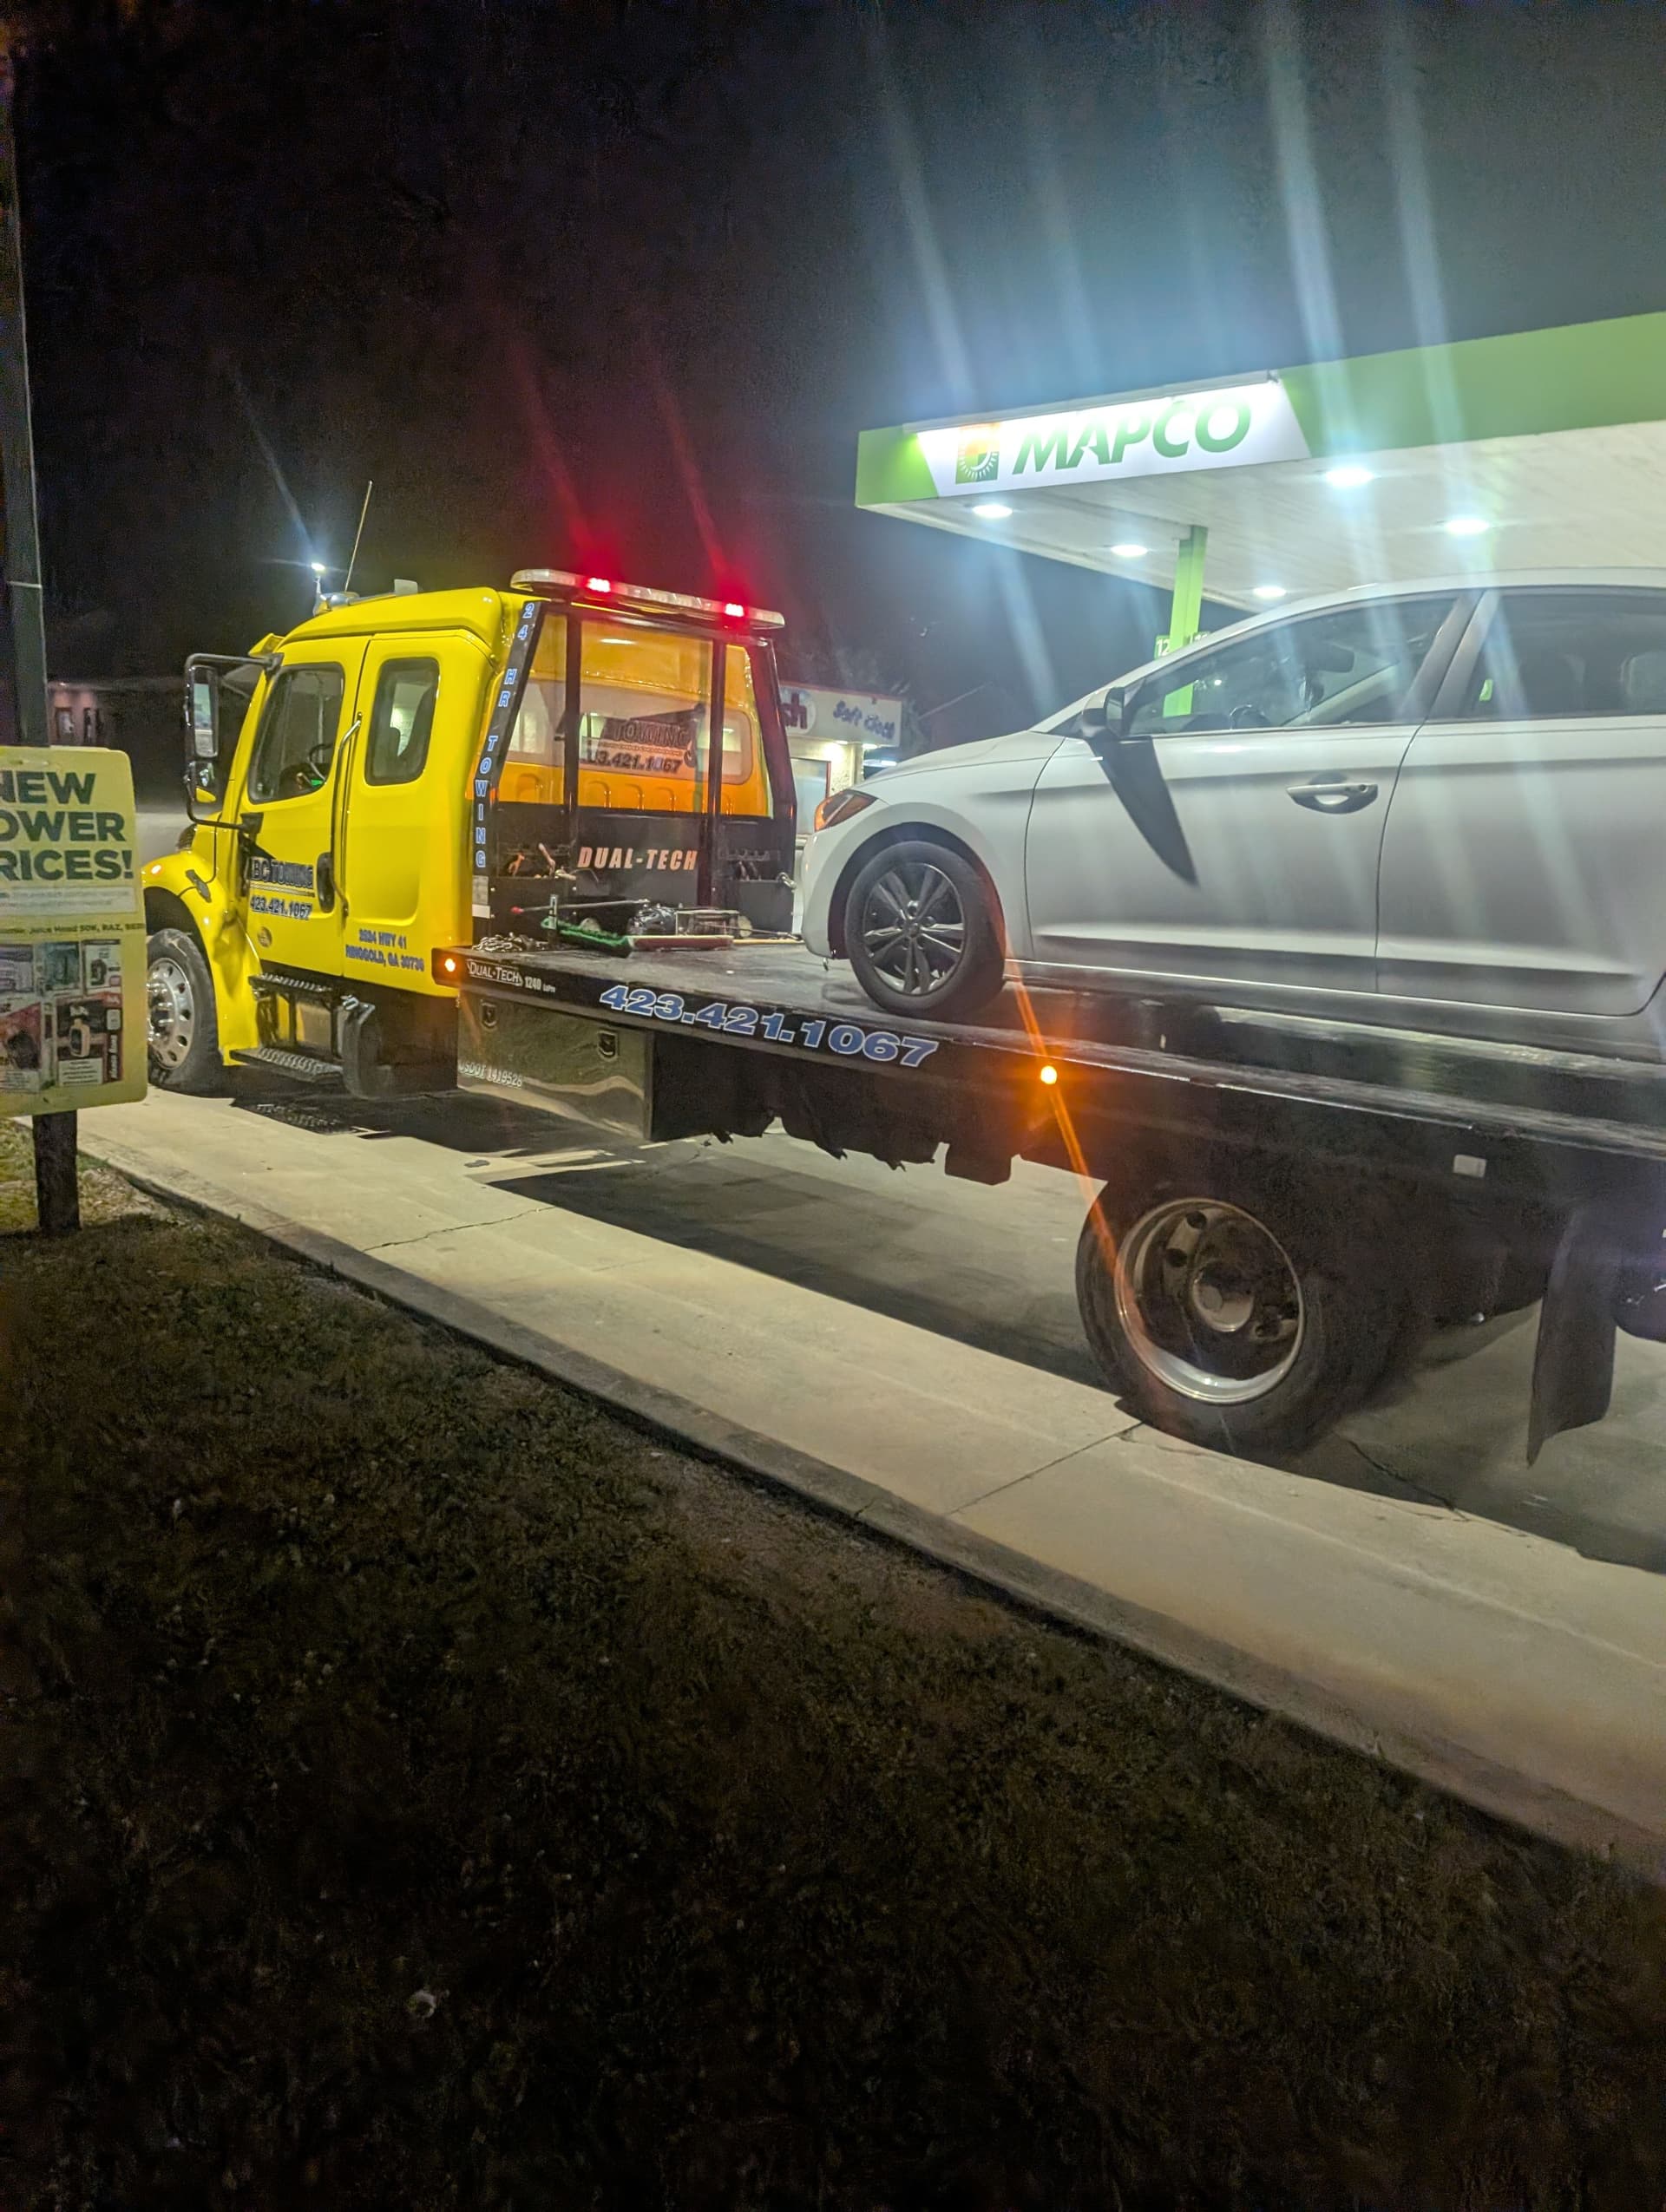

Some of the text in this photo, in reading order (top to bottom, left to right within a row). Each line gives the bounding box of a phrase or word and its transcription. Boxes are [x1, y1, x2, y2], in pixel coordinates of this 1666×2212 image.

[1012, 396, 1252, 475] MAPCO
[475, 602, 535, 868] 24 HR TOWING
[0, 809, 126, 841] OWER
[0, 849, 134, 881] RICES!
[577, 847, 698, 870] DUAL-TECH
[524, 976, 541, 991] 1240
[600, 985, 939, 1067] 423.421.1067
